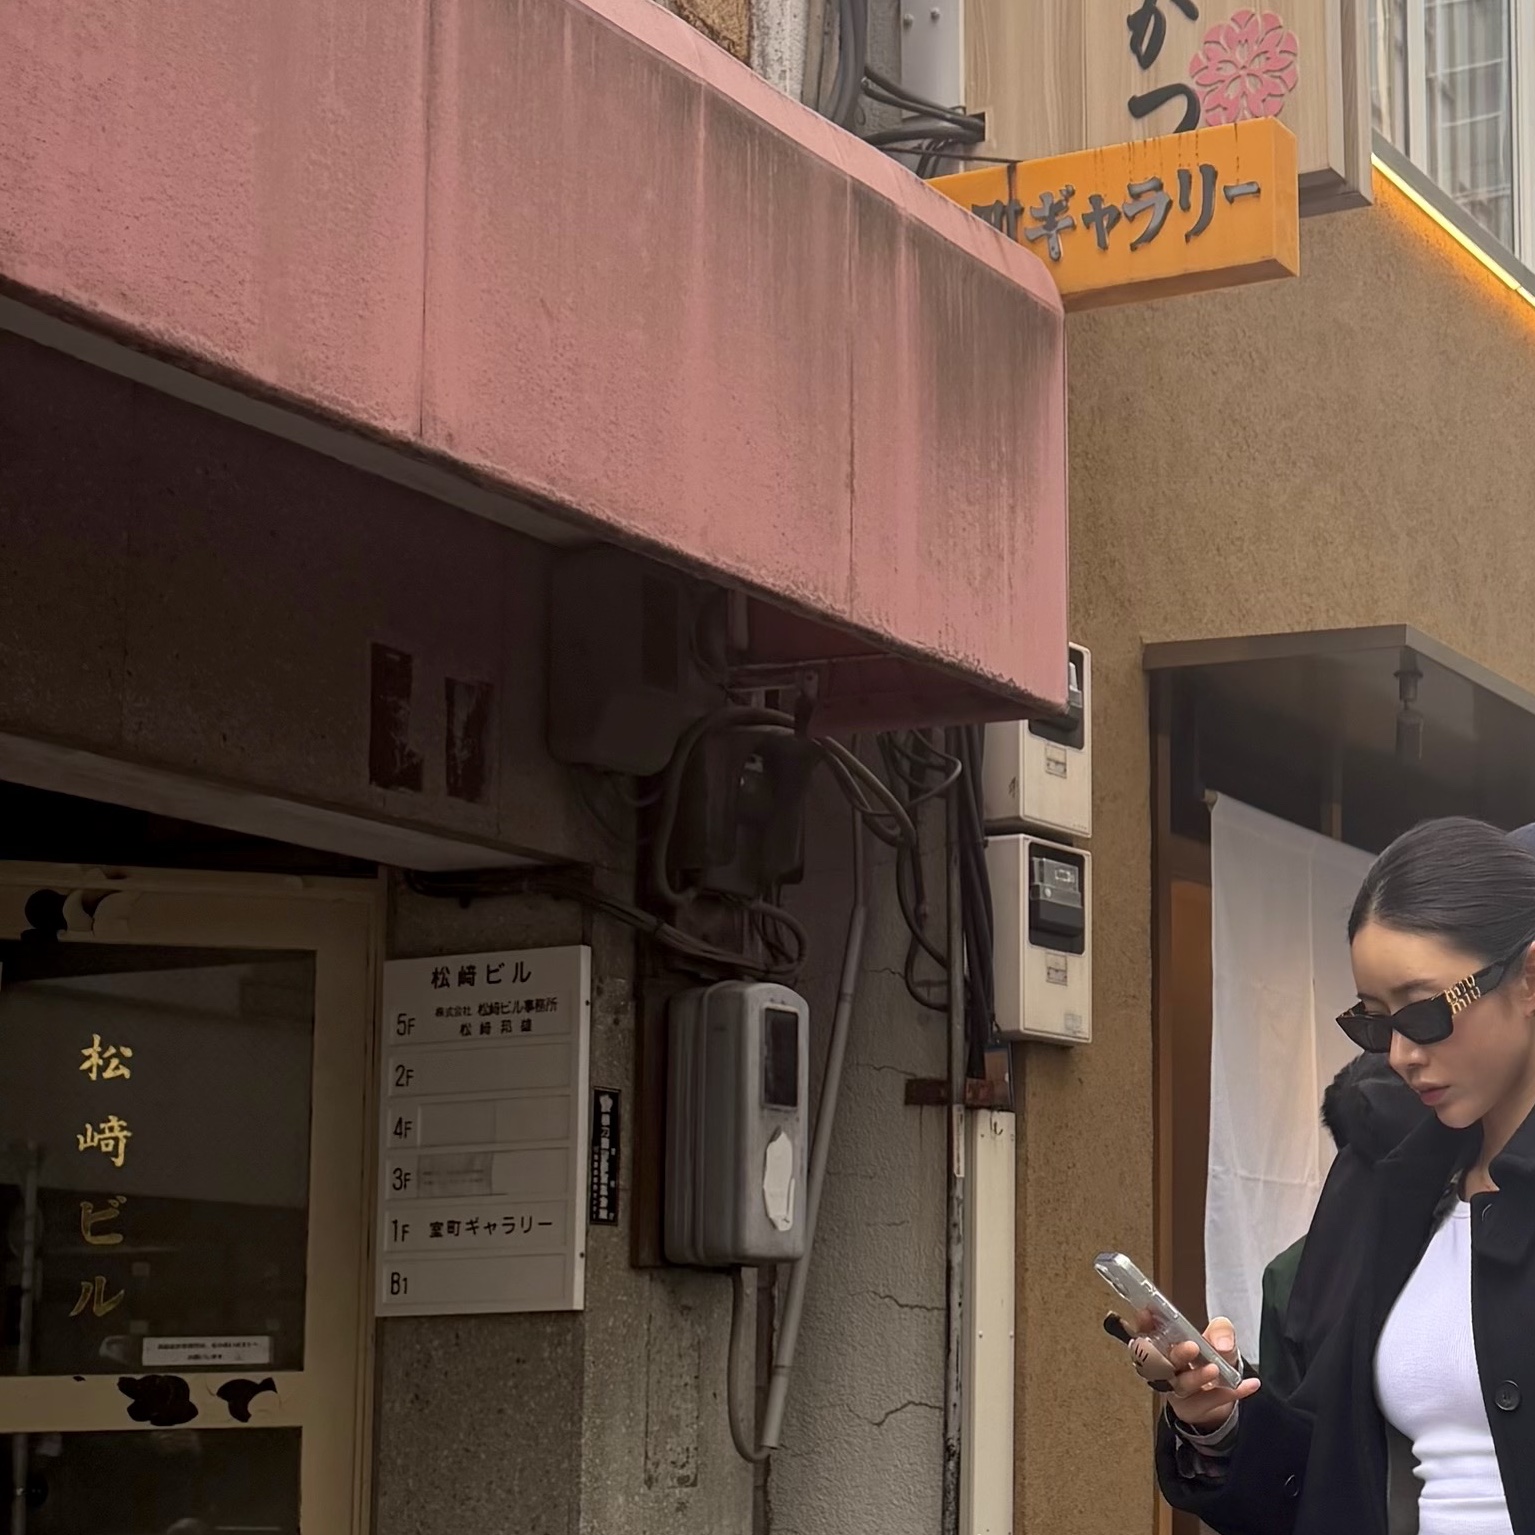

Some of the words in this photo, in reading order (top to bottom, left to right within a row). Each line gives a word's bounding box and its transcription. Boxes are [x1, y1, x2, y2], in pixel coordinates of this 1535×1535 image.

[396, 1013, 415, 1036] 5F
[395, 1065, 414, 1088] 2F
[393, 1116, 413, 1139] 4F
[392, 1168, 412, 1191] 3F
[391, 1219, 410, 1242] 1F
[428, 1215, 553, 1239] 室町ギャラリー
[390, 1272, 408, 1296] B1
